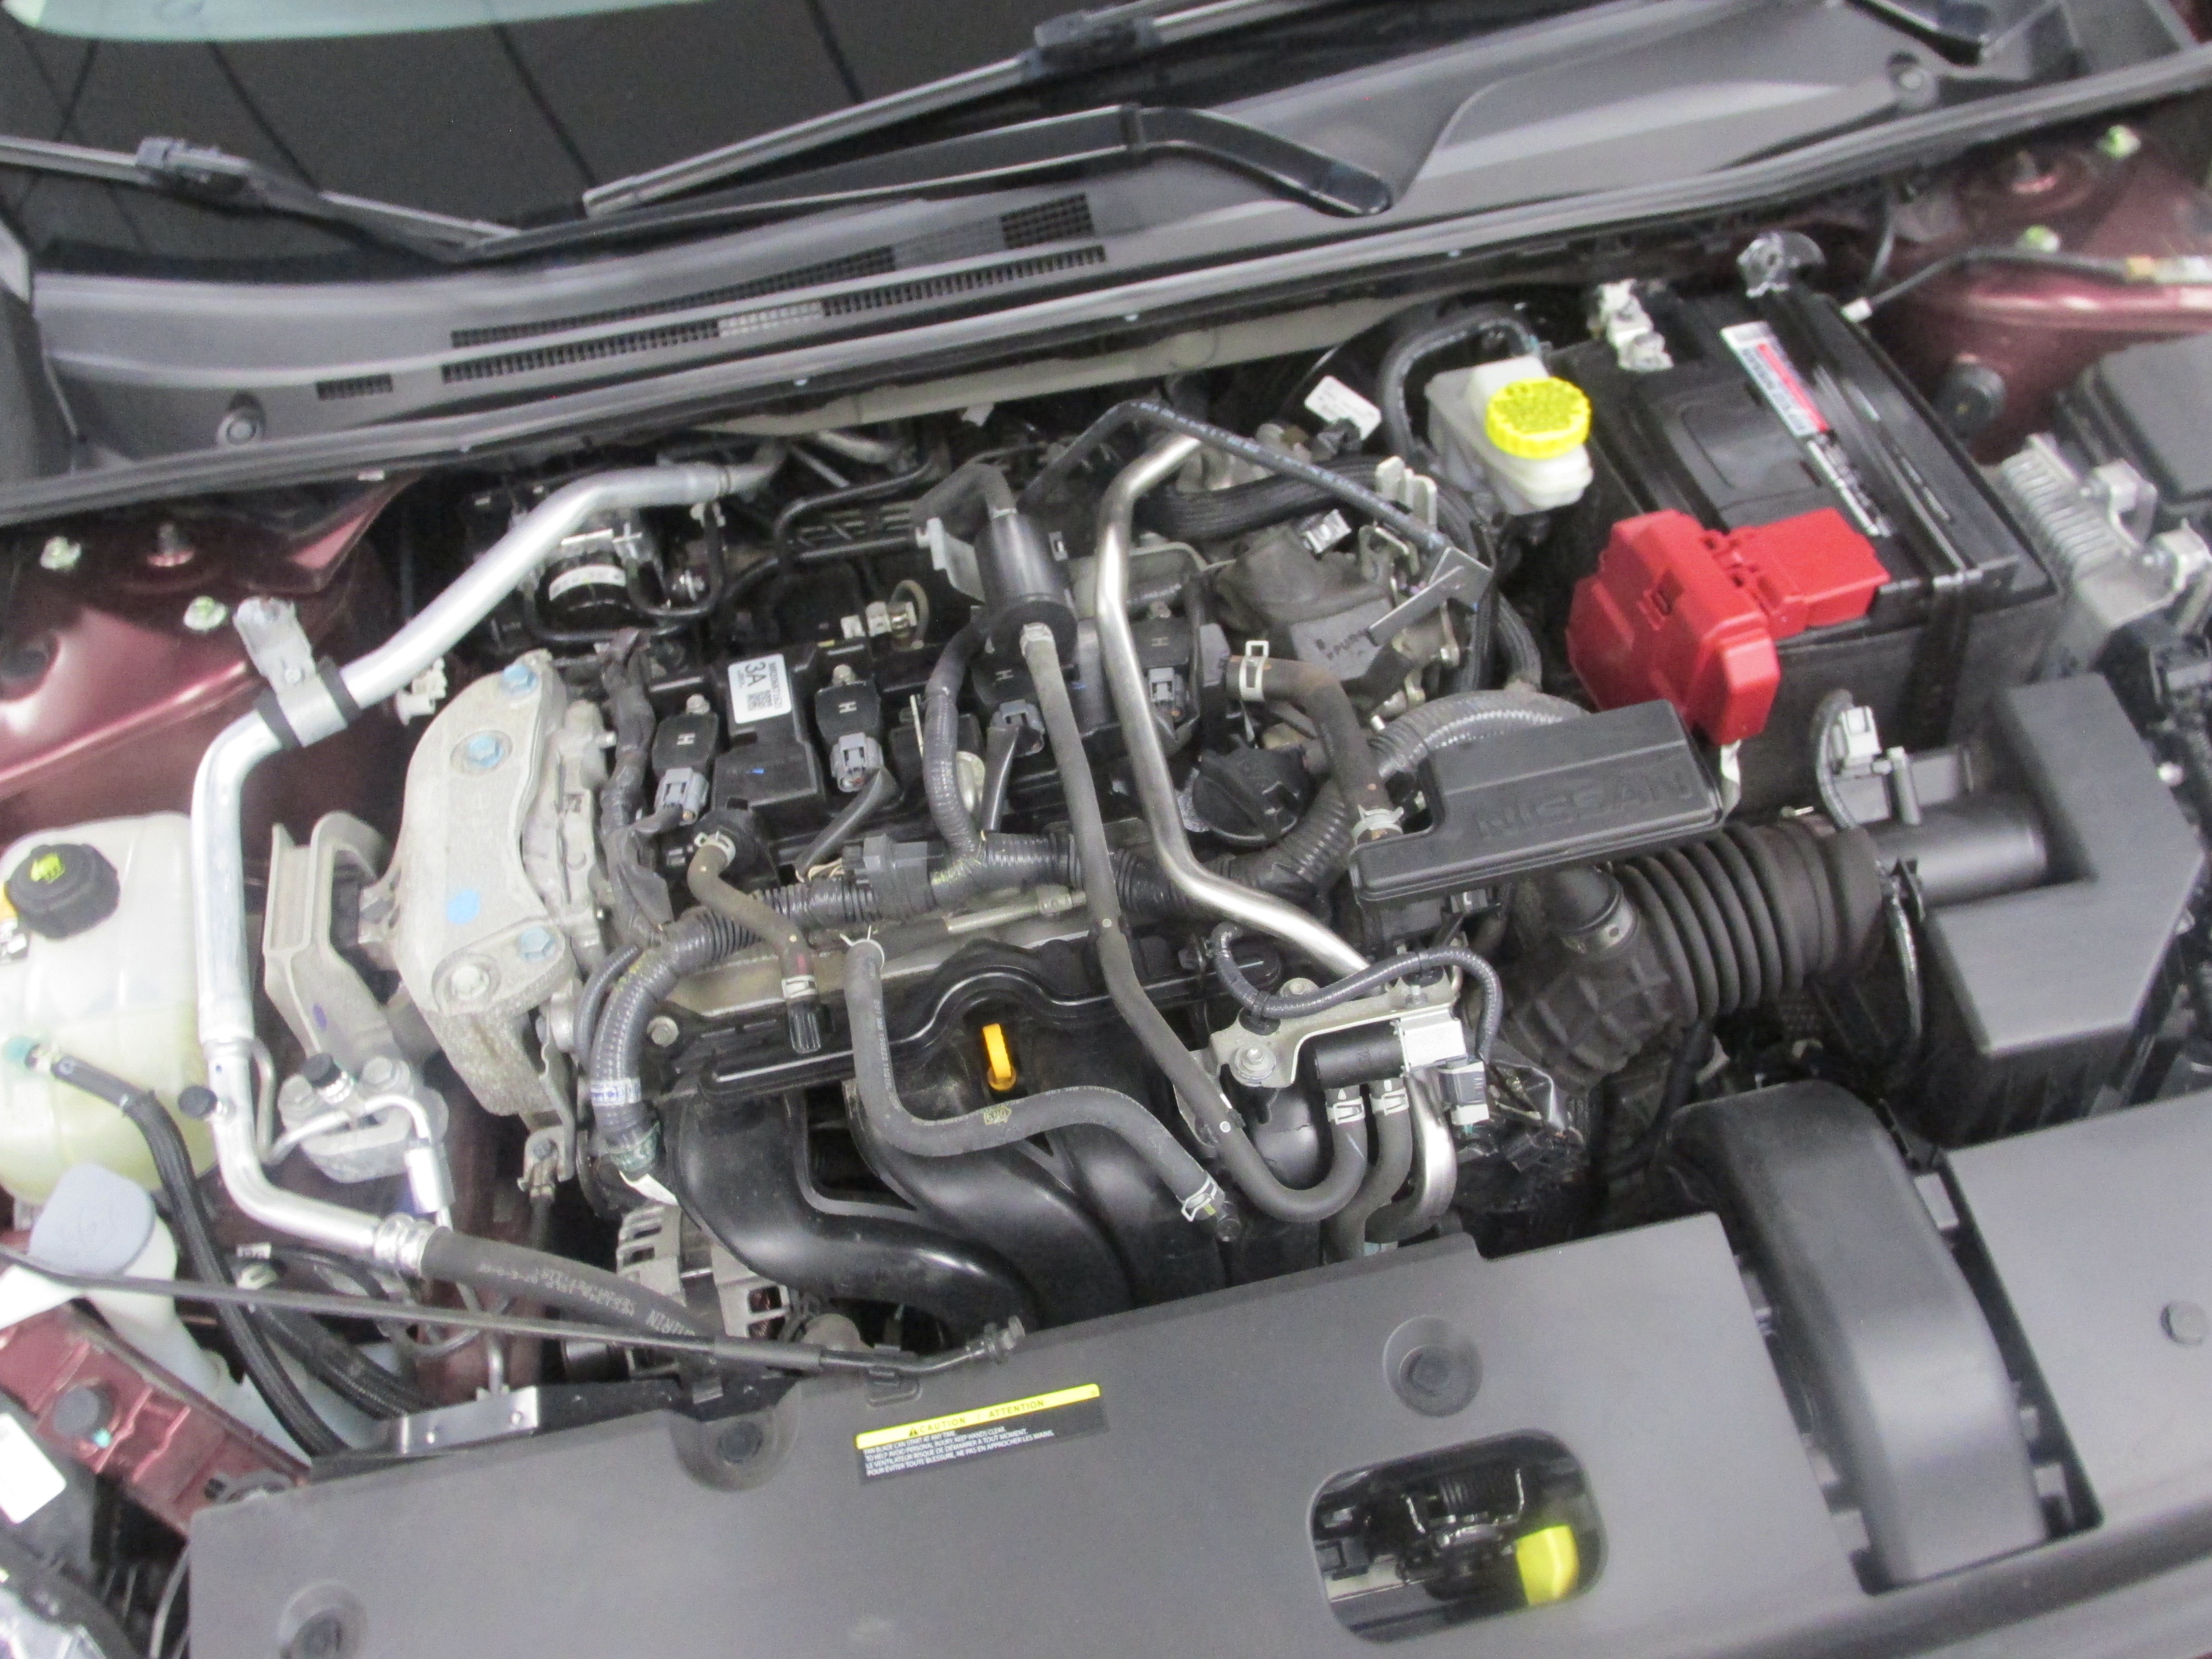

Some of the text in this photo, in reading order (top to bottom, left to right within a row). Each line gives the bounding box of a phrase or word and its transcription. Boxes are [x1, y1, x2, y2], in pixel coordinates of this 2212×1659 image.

[745, 662, 767, 686] 3A
[1473, 768, 1695, 838] NISSAN
[920, 1417, 965, 1432] CAUTION
[988, 1400, 1043, 1418] ATTENTION
